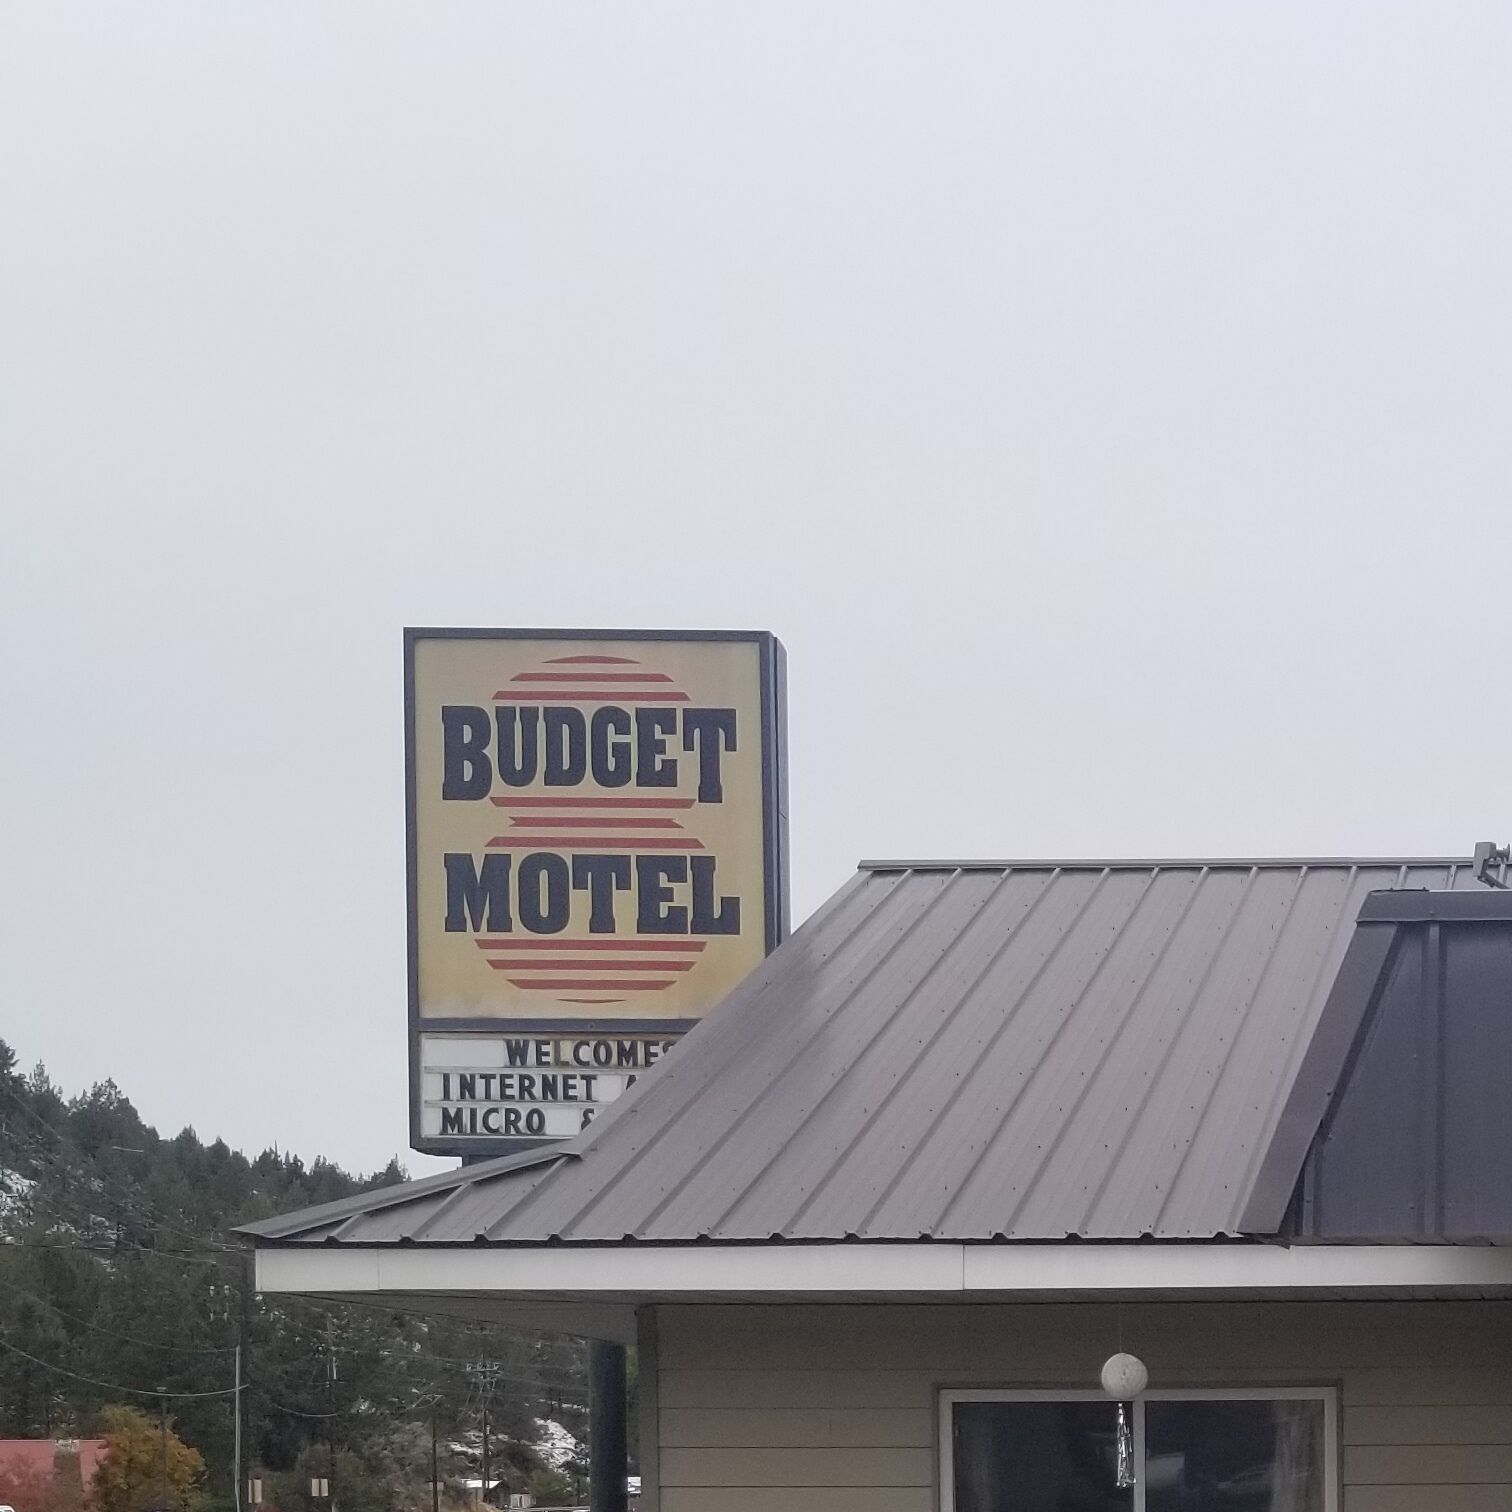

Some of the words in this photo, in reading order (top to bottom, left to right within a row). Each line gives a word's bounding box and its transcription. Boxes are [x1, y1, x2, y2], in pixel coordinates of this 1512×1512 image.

[441, 705, 738, 803] BUDGET
[443, 852, 741, 936] MOTEL
[443, 1073, 597, 1101] INTERNET
[442, 1107, 546, 1134] MICRO
